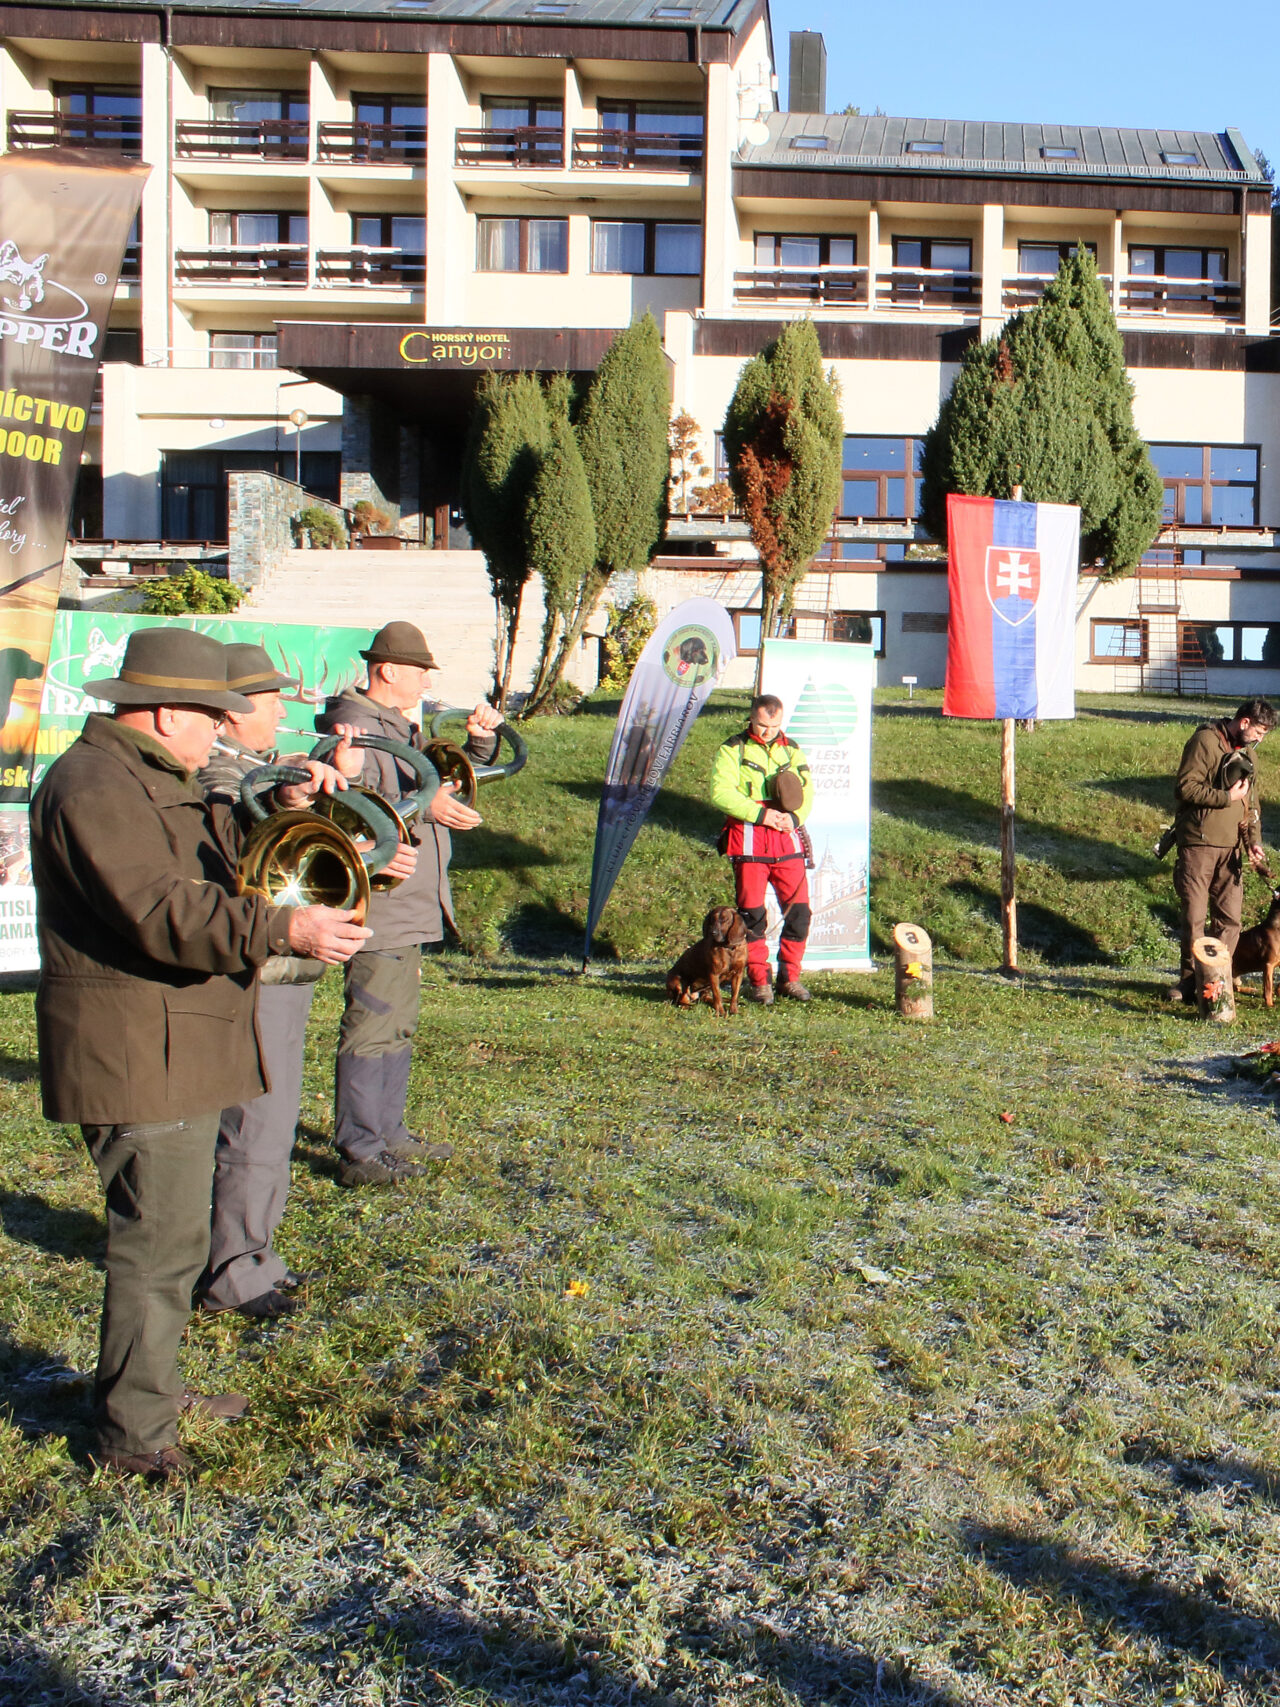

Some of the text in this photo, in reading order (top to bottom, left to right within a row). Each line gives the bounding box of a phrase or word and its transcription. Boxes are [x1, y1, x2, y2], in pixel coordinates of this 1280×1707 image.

[0, 318, 98, 359] PPER
[431, 332, 511, 343] HORSKÝ HOTEL
[0, 388, 86, 433] ÍCTVO
[815, 750, 849, 760] LESY
